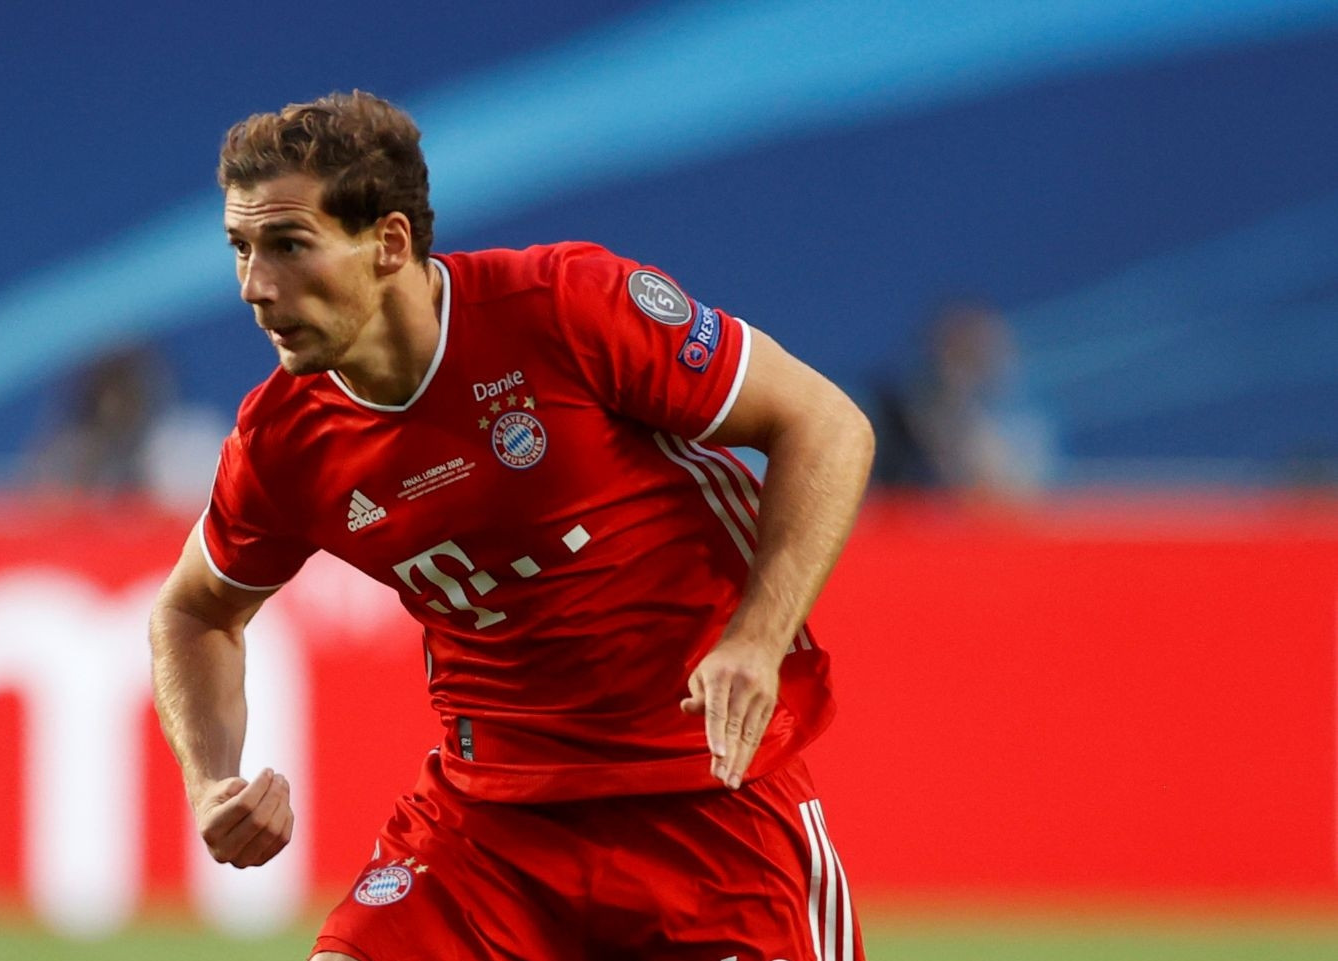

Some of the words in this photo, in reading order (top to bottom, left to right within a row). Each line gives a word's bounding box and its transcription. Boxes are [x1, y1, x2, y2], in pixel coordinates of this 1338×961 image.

[473, 370, 524, 402] Danke
[500, 415, 536, 430] BAYERN
[402, 475, 423, 488] FINAL
[422, 463, 447, 480] LISBON
[446, 457, 464, 471] 2020
[347, 506, 387, 532] adidas
